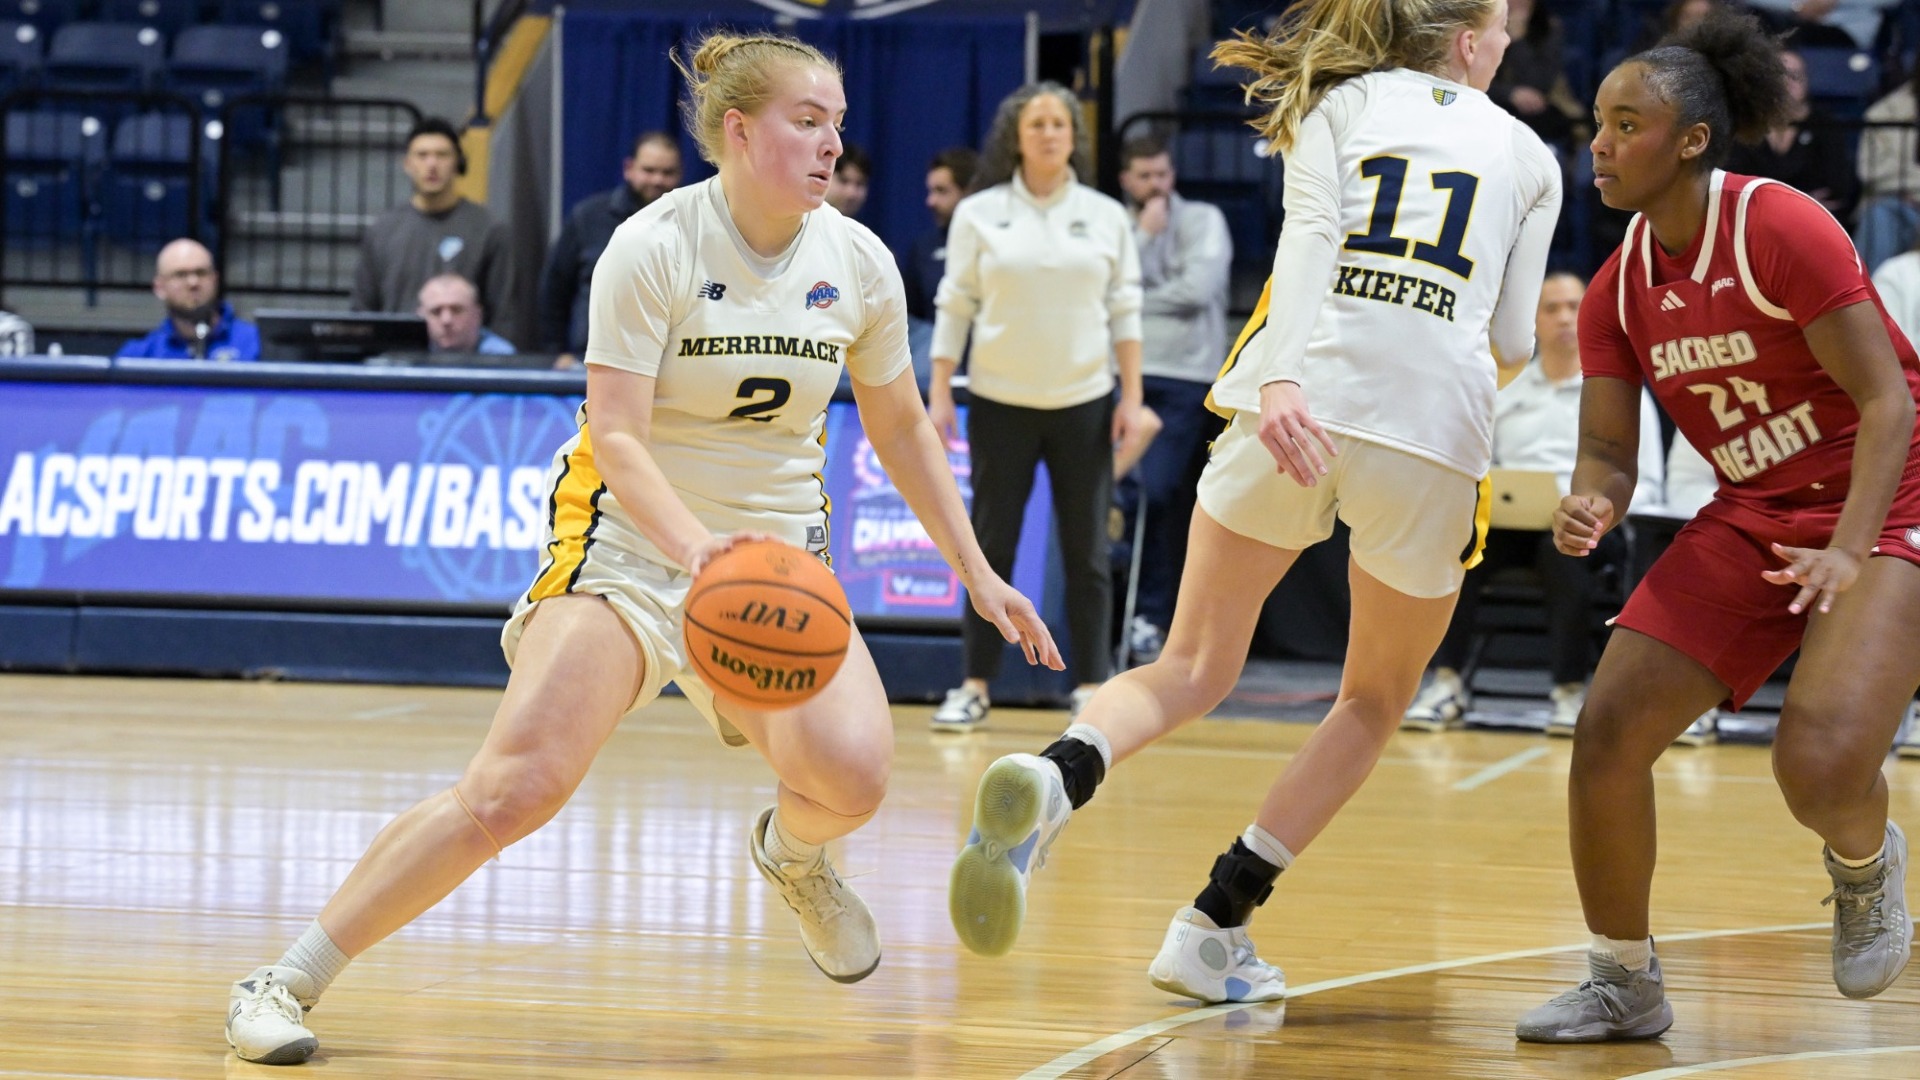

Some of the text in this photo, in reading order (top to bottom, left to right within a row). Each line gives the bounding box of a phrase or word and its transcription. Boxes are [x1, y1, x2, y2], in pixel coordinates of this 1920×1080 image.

[1341, 153, 1481, 282] 11
[805, 286, 840, 310] MAAC
[1333, 264, 1457, 323] KIEFER
[678, 335, 841, 365] MERRIMACK
[1650, 330, 1757, 382] SACRED
[729, 376, 792, 422] 2
[1686, 375, 1773, 432] 24
[1711, 400, 1823, 484] HEART
[0, 452, 549, 549] ACSPORTS.COM/BAS
[711, 643, 816, 691] Wilson
